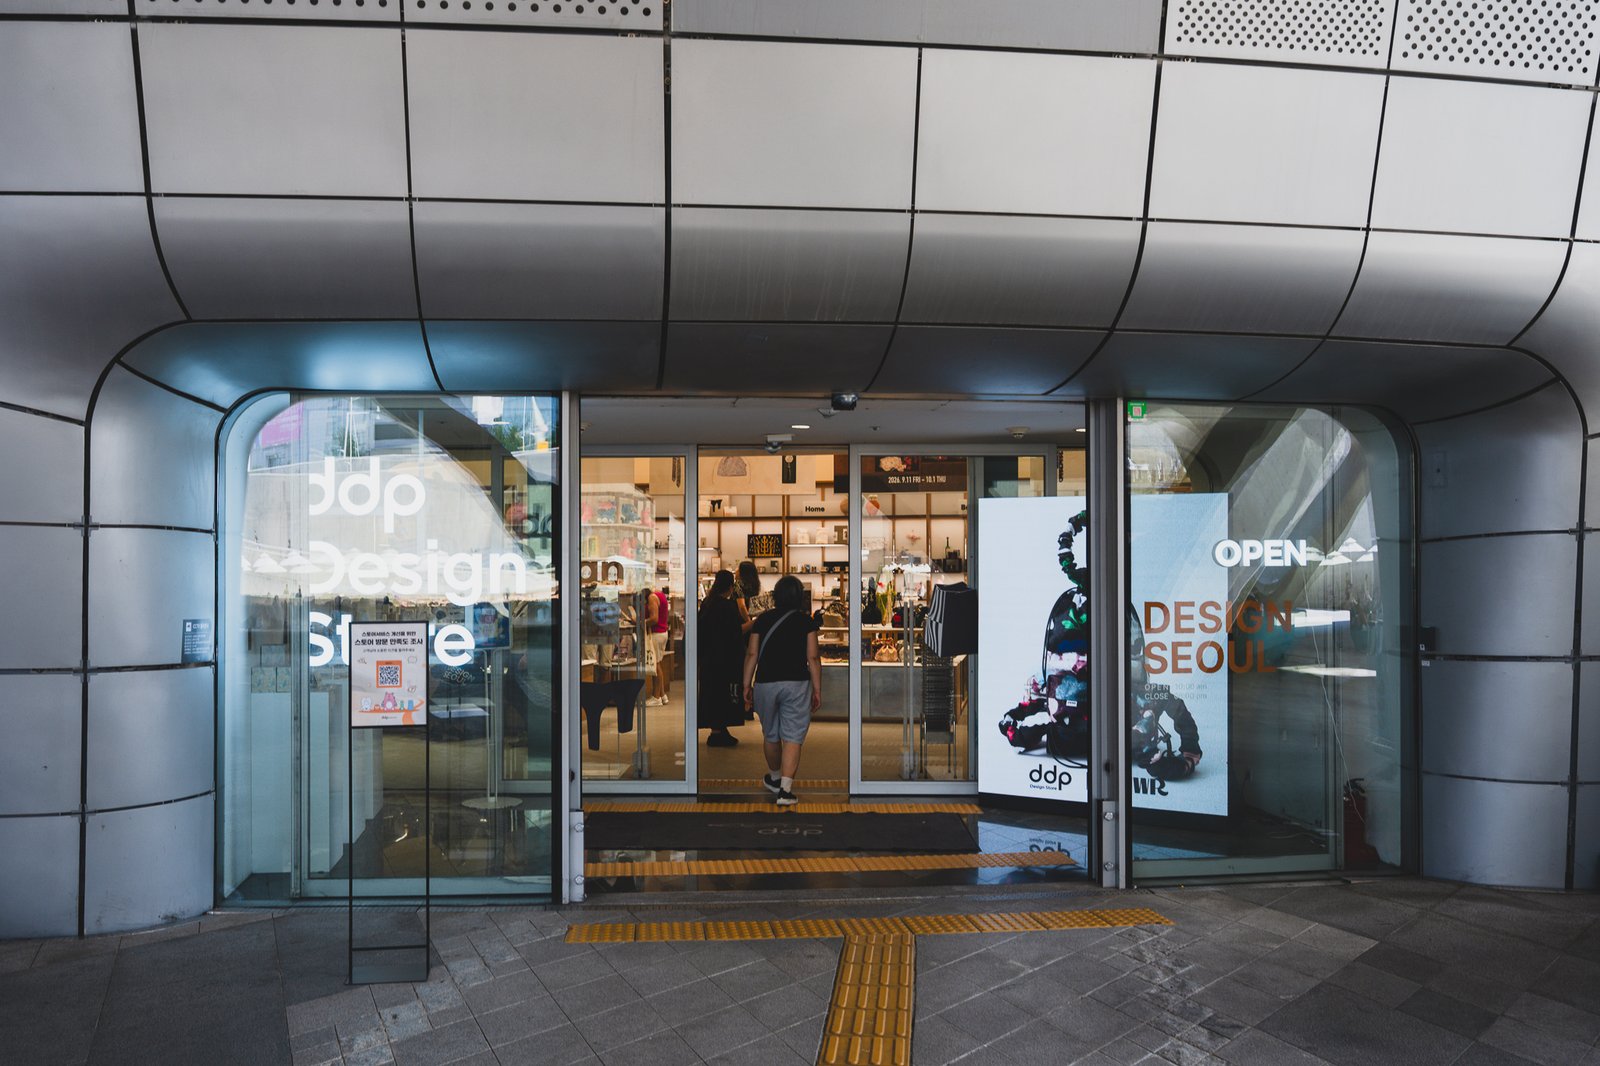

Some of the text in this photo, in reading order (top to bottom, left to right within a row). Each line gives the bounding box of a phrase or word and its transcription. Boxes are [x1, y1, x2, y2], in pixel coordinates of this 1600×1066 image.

[936, 475, 947, 483] THU
[1212, 539, 1307, 568] OPEN
[309, 539, 527, 607] Design
[1144, 600, 1293, 634] DESIGN
[309, 611, 475, 667] Ste
[410, 637, 423, 645] 조사
[1144, 640, 1277, 675] SEOUL
[1144, 683, 1169, 691] OPEN
[1144, 692, 1169, 700] CLOSE
[1029, 764, 1072, 791] ddp
